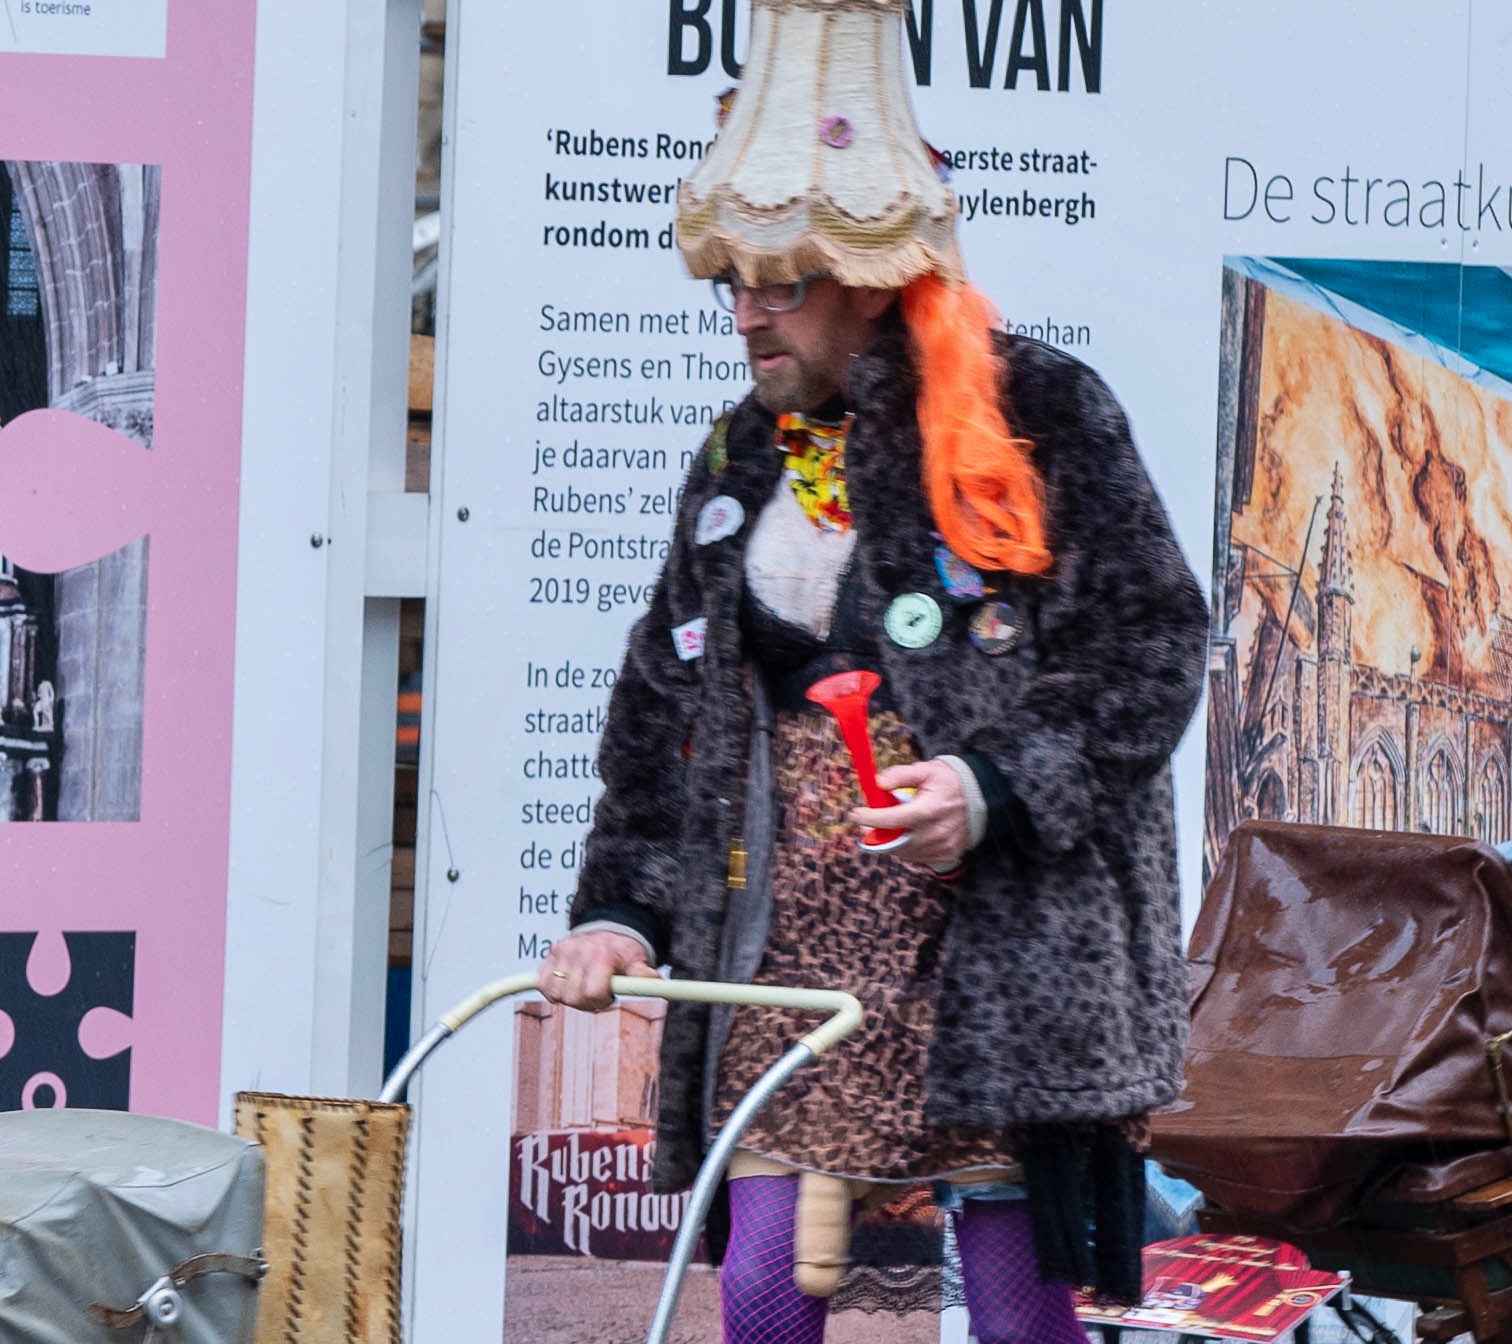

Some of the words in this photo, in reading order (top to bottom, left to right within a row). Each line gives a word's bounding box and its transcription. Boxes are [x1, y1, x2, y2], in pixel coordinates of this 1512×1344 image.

[21, 0, 30, 14] is
[35, 1, 91, 16] toerisme
[1019, 148, 1097, 175] straat-
[544, 174, 681, 205] kunstwer
[1222, 156, 1294, 224] De
[544, 220, 649, 248] rondom
[540, 304, 629, 333] Samen
[640, 310, 689, 335] met
[539, 350, 631, 384] Gysens
[641, 359, 671, 379] en
[537, 394, 664, 424] altaarstuk
[670, 401, 714, 425] van
[532, 440, 556, 475] je
[563, 440, 666, 470] daarvan
[534, 485, 632, 514] Rubens’
[531, 529, 561, 558] de
[529, 577, 590, 604] 2019
[528, 662, 547, 688] In
[556, 660, 585, 688] de
[520, 841, 552, 869] de
[520, 886, 558, 914] het
